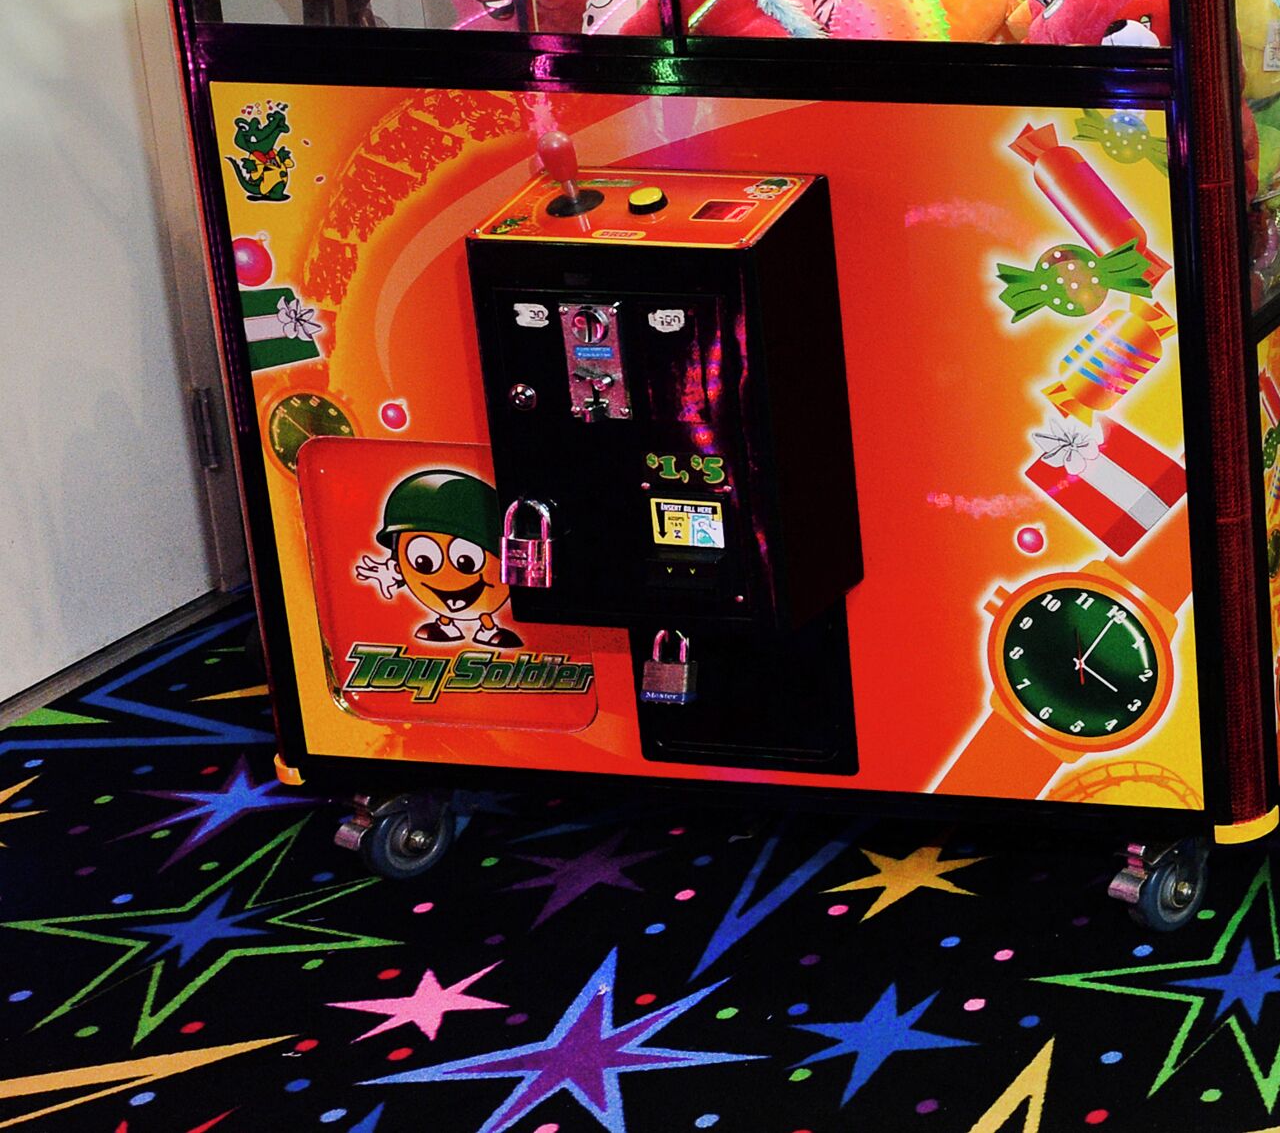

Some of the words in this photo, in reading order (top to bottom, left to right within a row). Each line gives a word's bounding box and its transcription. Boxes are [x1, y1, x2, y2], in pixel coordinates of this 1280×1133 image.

[691, 453, 726, 483] $5
[661, 502, 682, 511] INSERT
[684, 505, 696, 513] BILL
[697, 506, 713, 514] HERE
[342, 642, 452, 703] Toy
[442, 648, 595, 693] Soldier
[645, 691, 678, 700] Master
